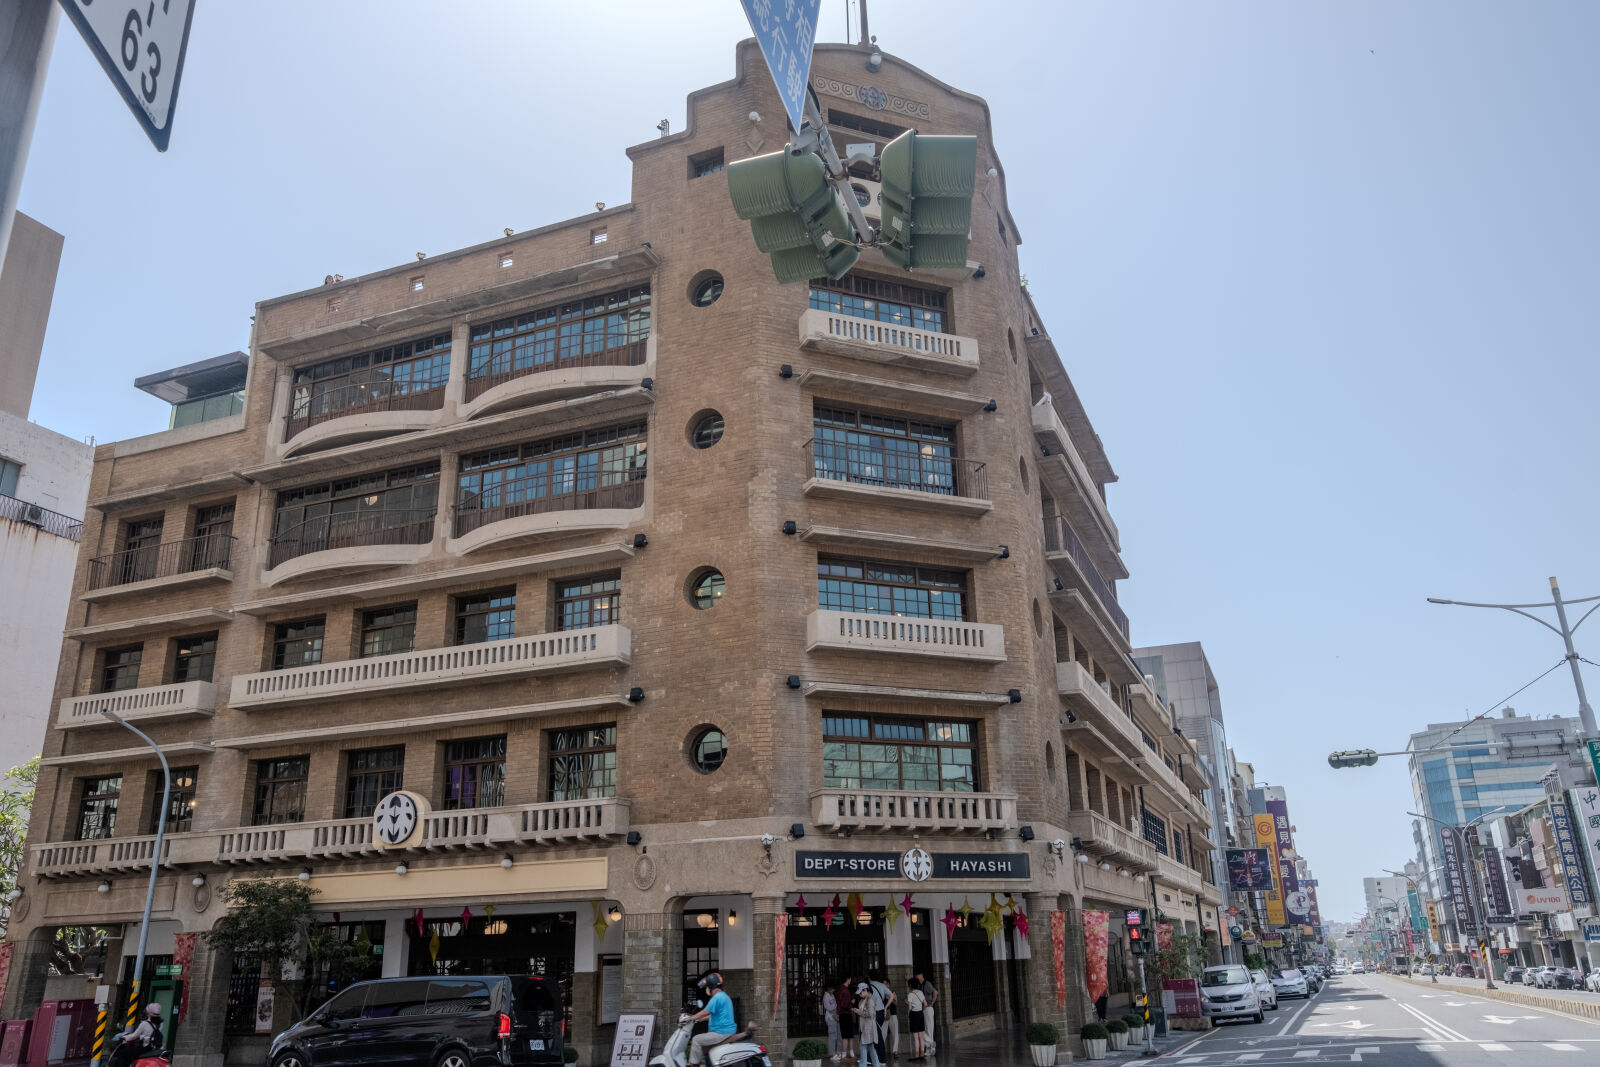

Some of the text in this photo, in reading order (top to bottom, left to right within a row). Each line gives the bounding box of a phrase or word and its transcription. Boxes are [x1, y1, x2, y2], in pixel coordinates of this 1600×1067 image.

[804, 858, 1012, 873] DEP'T-STORE HAYASHI
[1536, 896, 1561, 904] UV100
